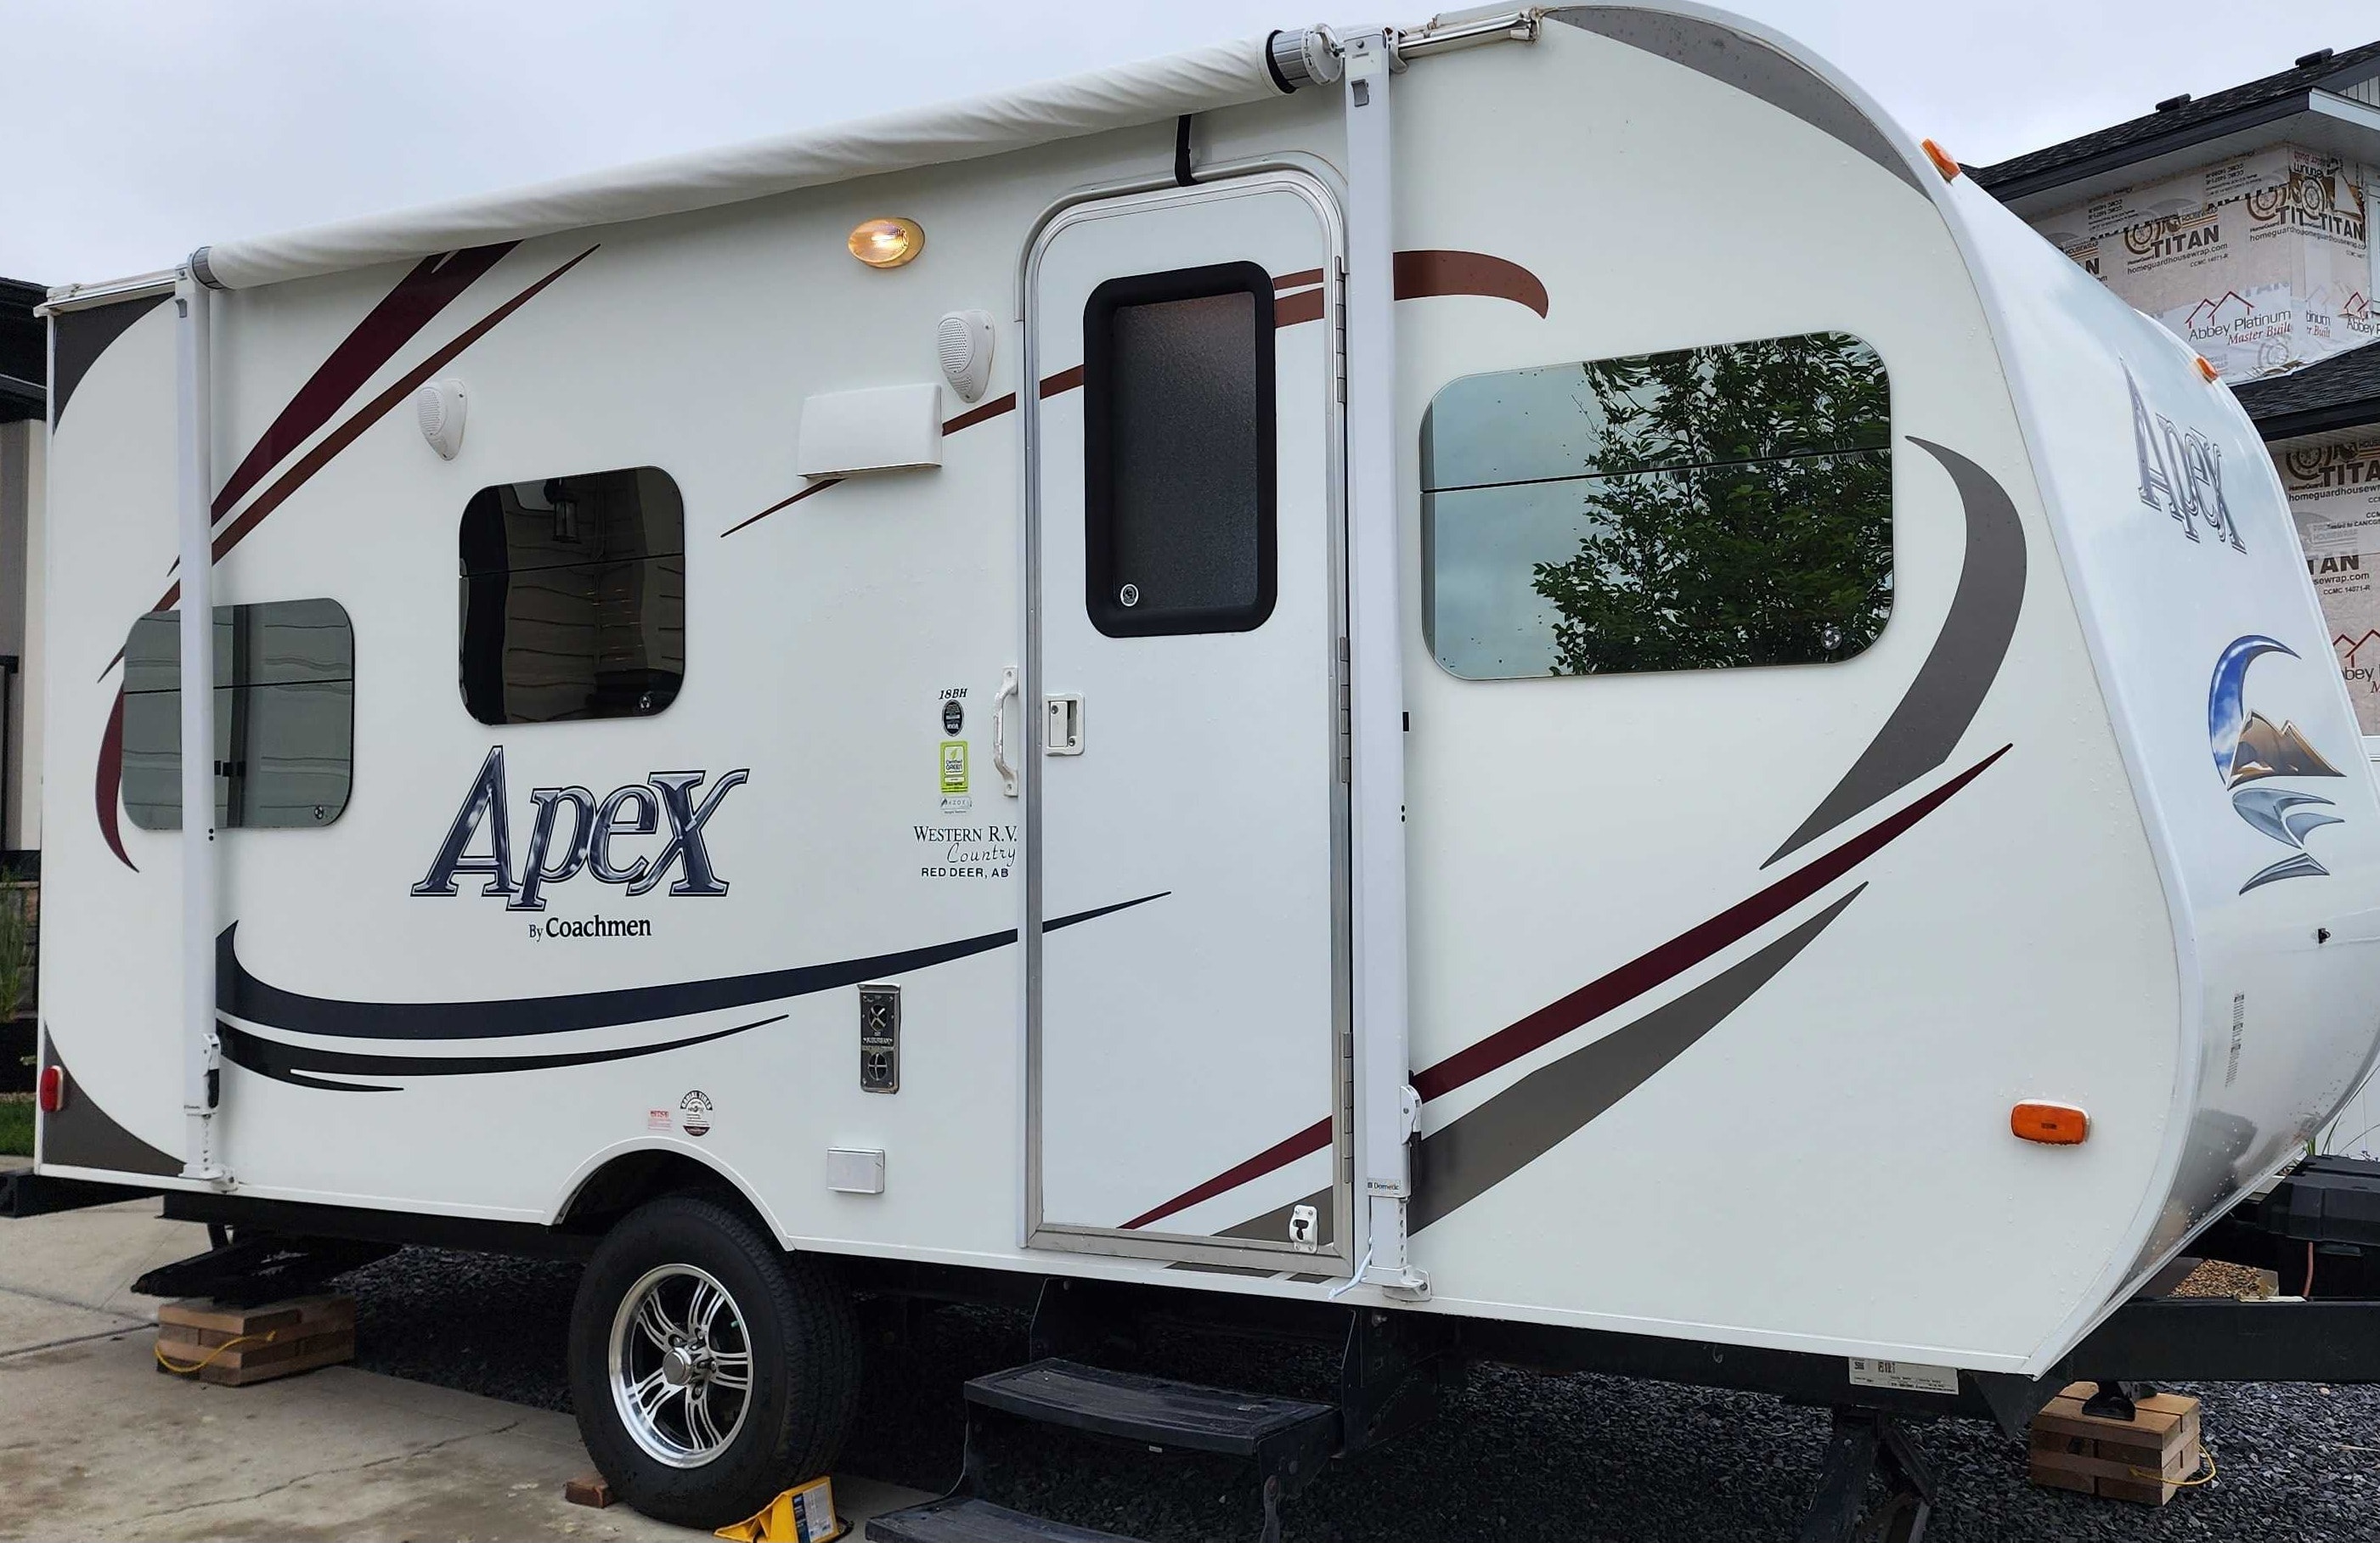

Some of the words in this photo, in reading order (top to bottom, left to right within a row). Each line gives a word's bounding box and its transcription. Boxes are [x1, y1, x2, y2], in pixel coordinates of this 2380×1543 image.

[2276, 206, 2304, 227] TIT
[2319, 213, 2363, 242] TITAN
[2151, 224, 2219, 258] TITAN
[2127, 243, 2228, 274] homeguardhousewrap.com
[2189, 322, 2231, 341] Abbey
[2235, 310, 2291, 331] Platinum
[2228, 329, 2264, 346] Master
[2266, 321, 2291, 338] Built
[2347, 318, 2374, 335] Abbey
[2319, 459, 2380, 487] TITA
[2314, 572, 2370, 586] sewrap.com
[939, 688, 967, 700] 18BH
[410, 745, 750, 911] Apex
[913, 825, 982, 842] WESTERN
[989, 825, 1018, 842] R.V.
[947, 842, 1016, 867] Country
[922, 867, 946, 877] RED
[950, 867, 988, 879] DEER,
[991, 868, 1009, 878] AB
[529, 924, 543, 943] By
[545, 915, 651, 938] Coachmen
